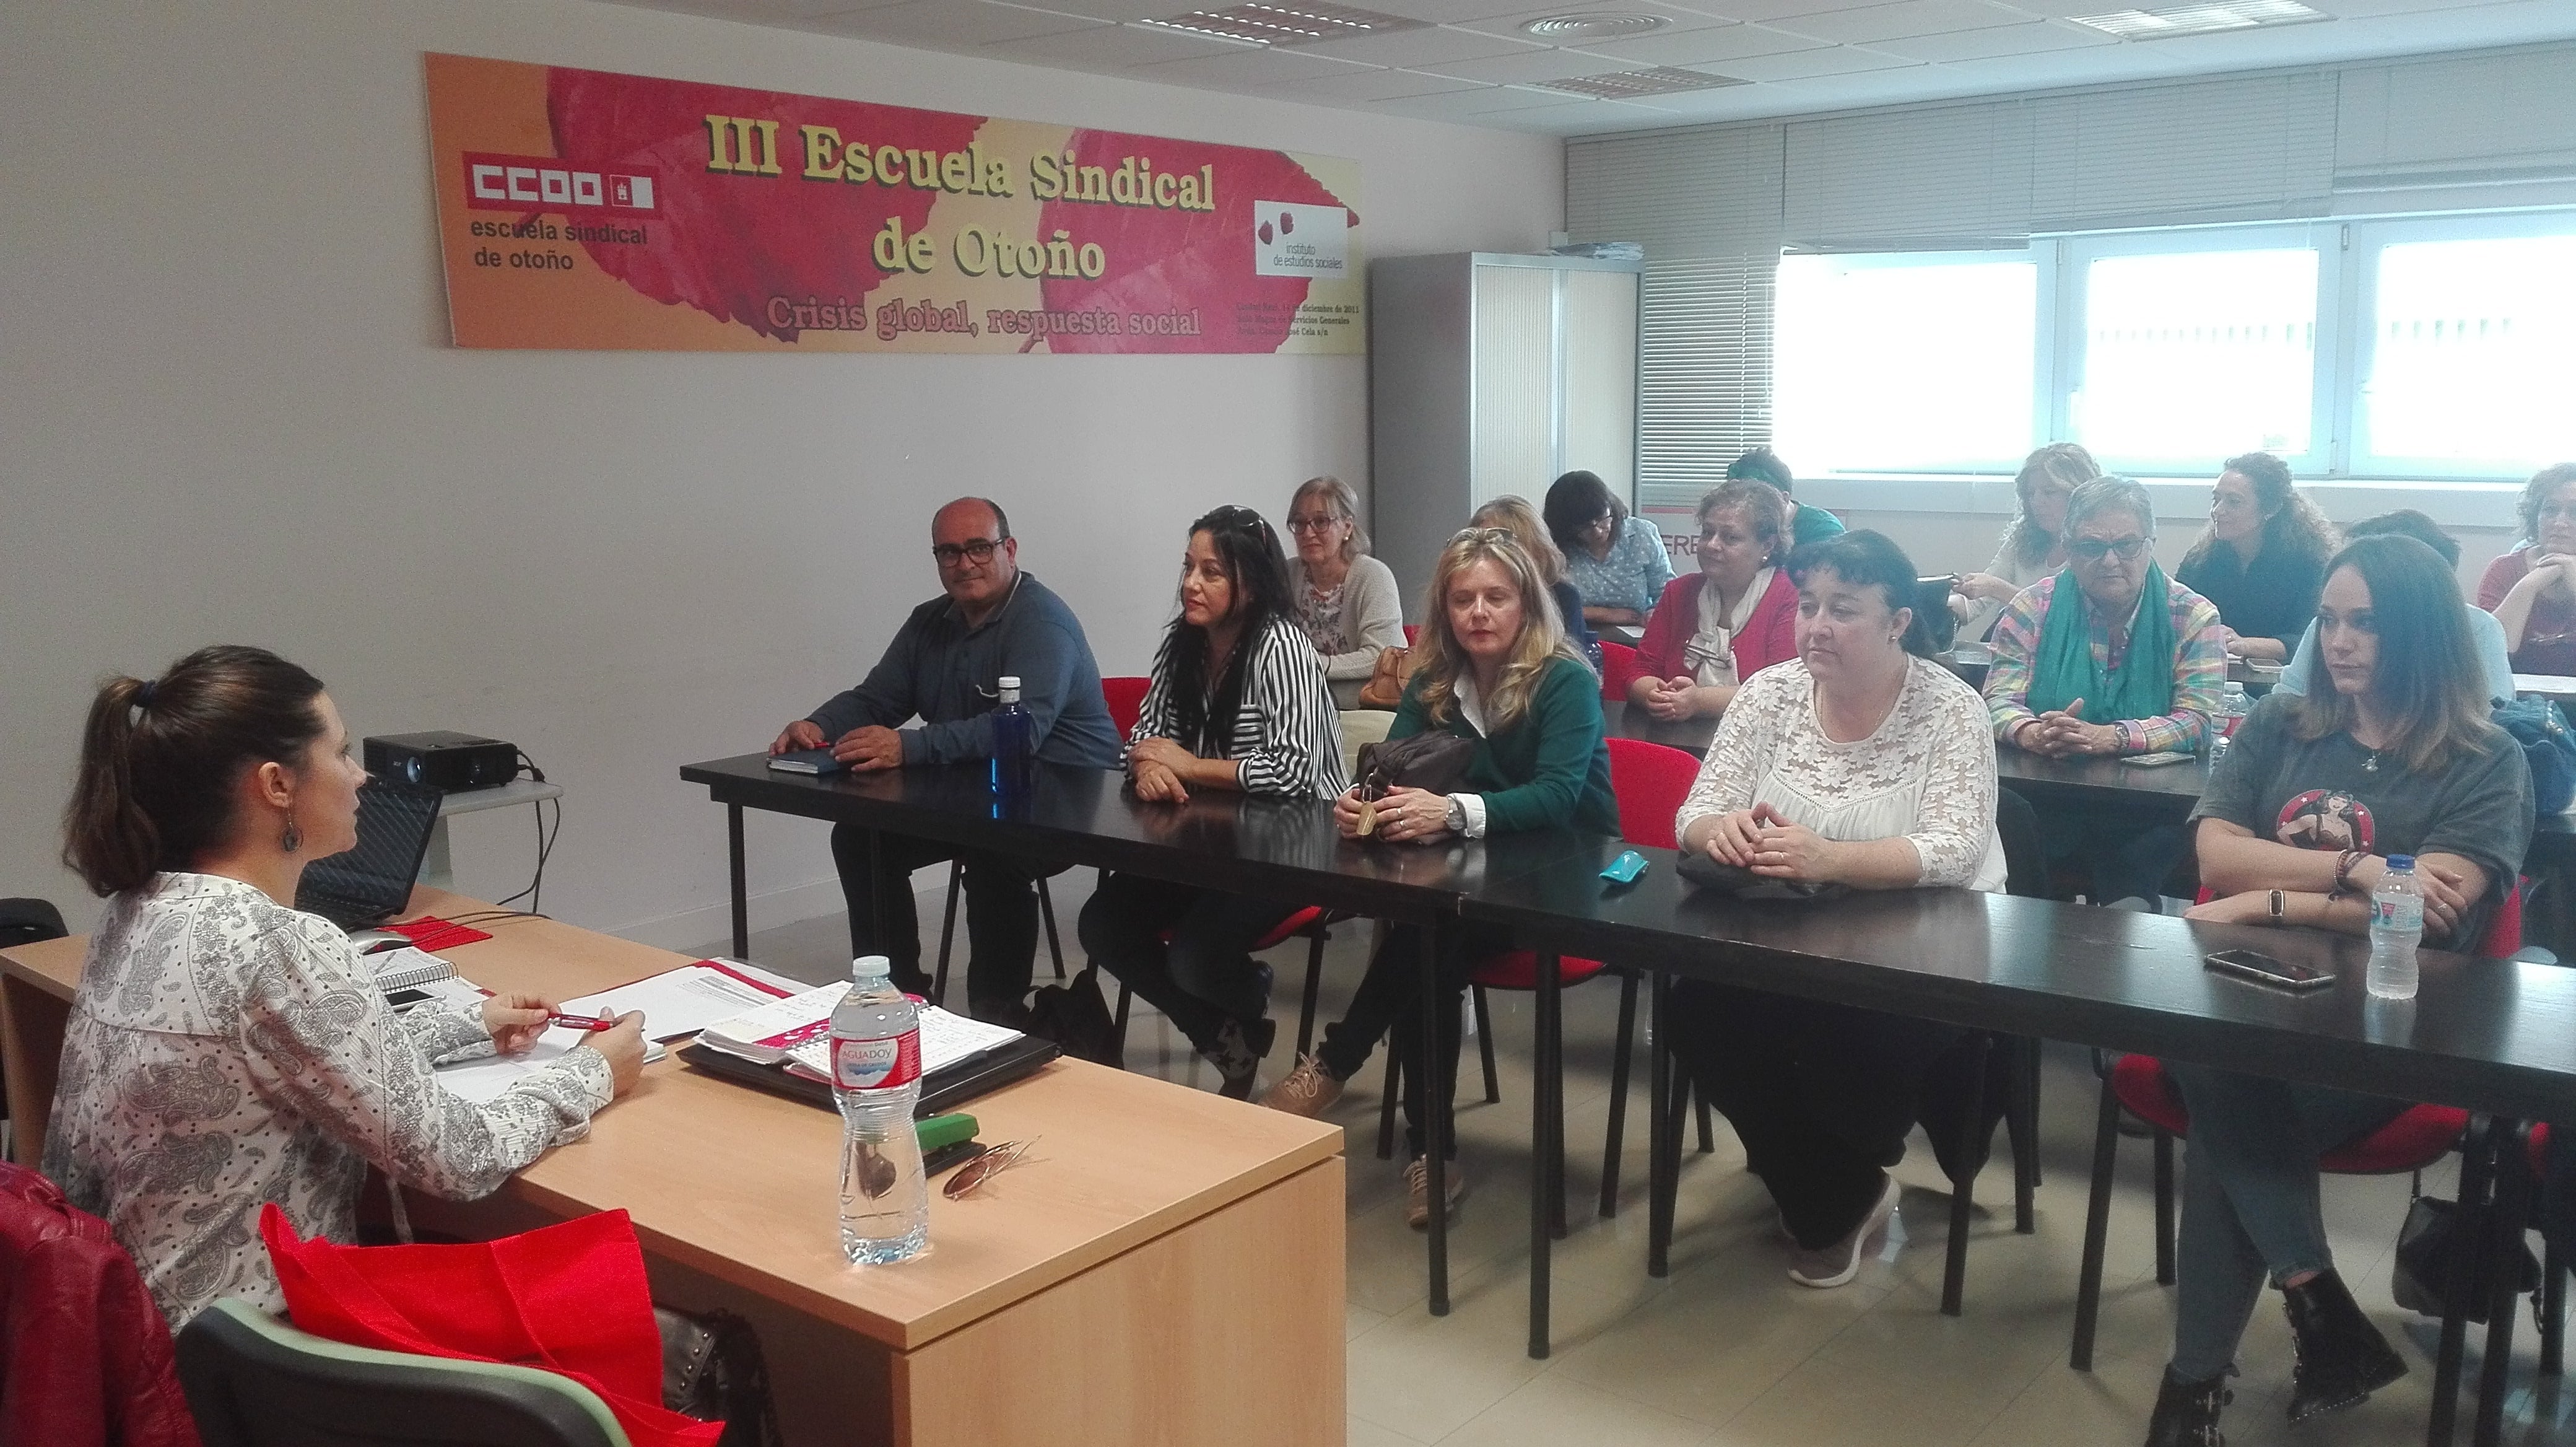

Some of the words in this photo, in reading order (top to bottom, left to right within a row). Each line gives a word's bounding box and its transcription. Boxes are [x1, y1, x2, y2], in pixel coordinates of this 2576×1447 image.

[703, 114, 782, 178] III
[799, 124, 1013, 198] Escuela
[1030, 150, 1214, 214] Sindical
[472, 164, 603, 206] CCOO
[471, 219, 557, 240] escuela
[565, 223, 648, 245] sindical
[872, 216, 936, 274] de
[954, 222, 1106, 280] Otoño
[1286, 242, 1316, 255] instituto
[474, 247, 502, 268] de
[509, 249, 574, 270] otoño
[1273, 254, 1283, 266] de
[1284, 255, 1314, 268] estudios
[1315, 256, 1342, 269] sociales
[1302, 304, 1333, 313] diciembre
[767, 295, 868, 331] Crisis
[876, 298, 978, 341] global,
[986, 306, 1121, 342] respuesta
[1128, 307, 1201, 336] social
[1320, 316, 1350, 325] Generales
[1302, 327, 1316, 336] Cela
[842, 1048, 892, 1059] AGUADOY
